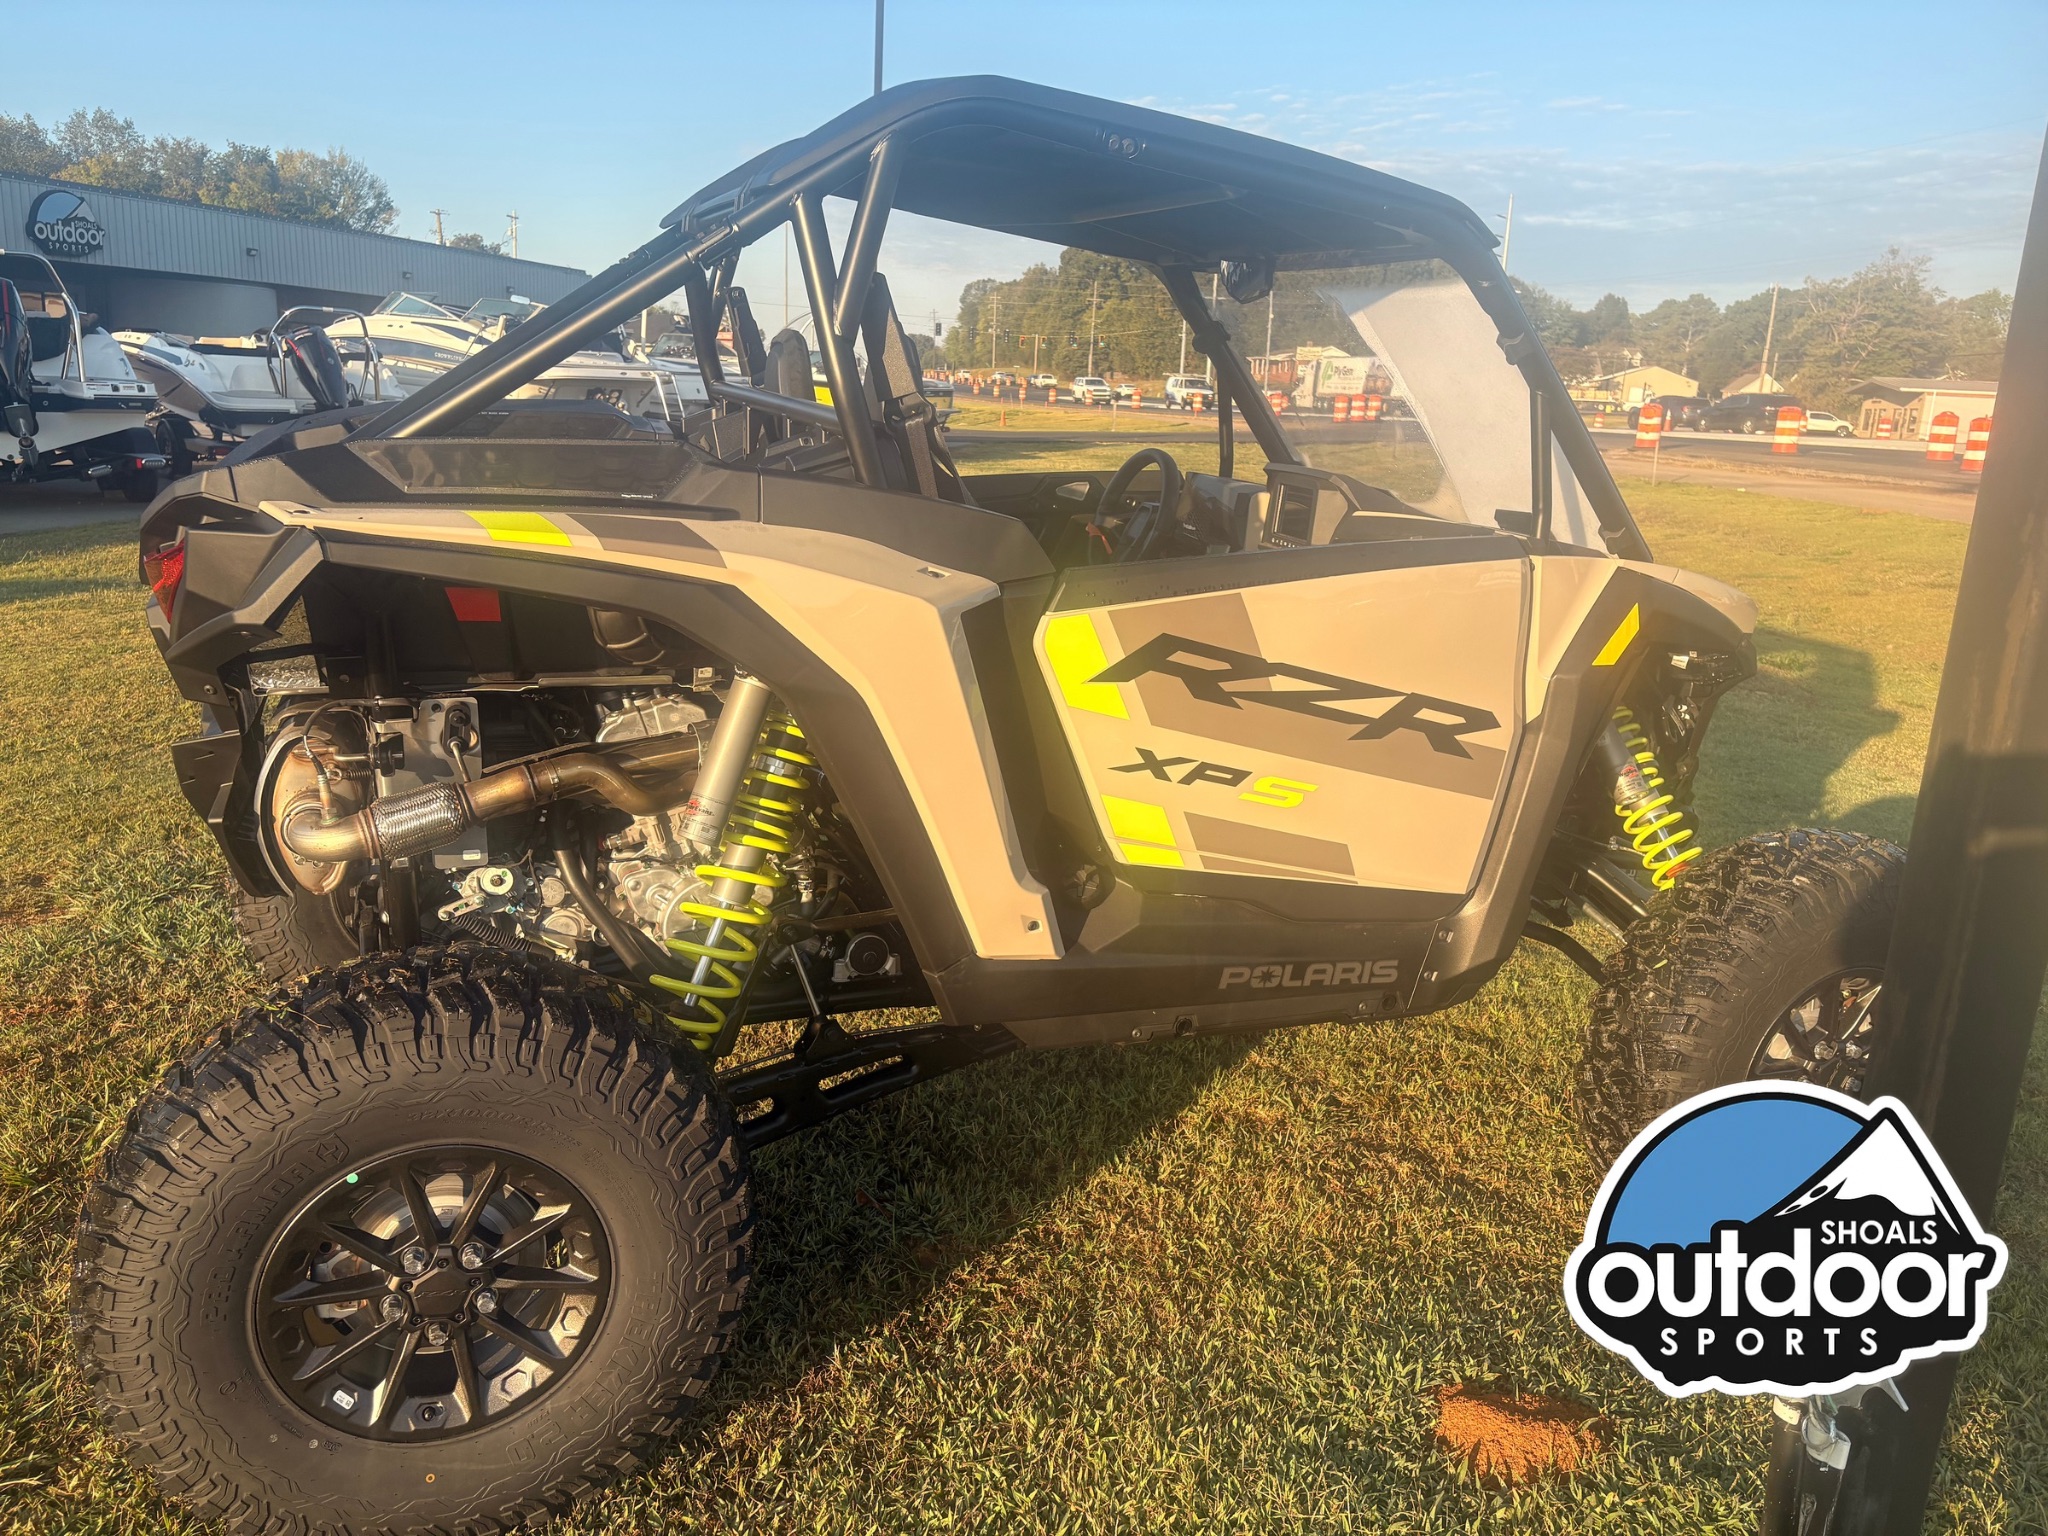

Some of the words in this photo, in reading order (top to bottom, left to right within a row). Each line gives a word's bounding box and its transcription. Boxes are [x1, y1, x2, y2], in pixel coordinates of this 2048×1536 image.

[34, 220, 105, 246] outdoor
[75, 220, 98, 230] SHOALS
[48, 241, 89, 253] SPORTS
[1082, 632, 1502, 760] RZR
[1217, 959, 1399, 990] POLARIS
